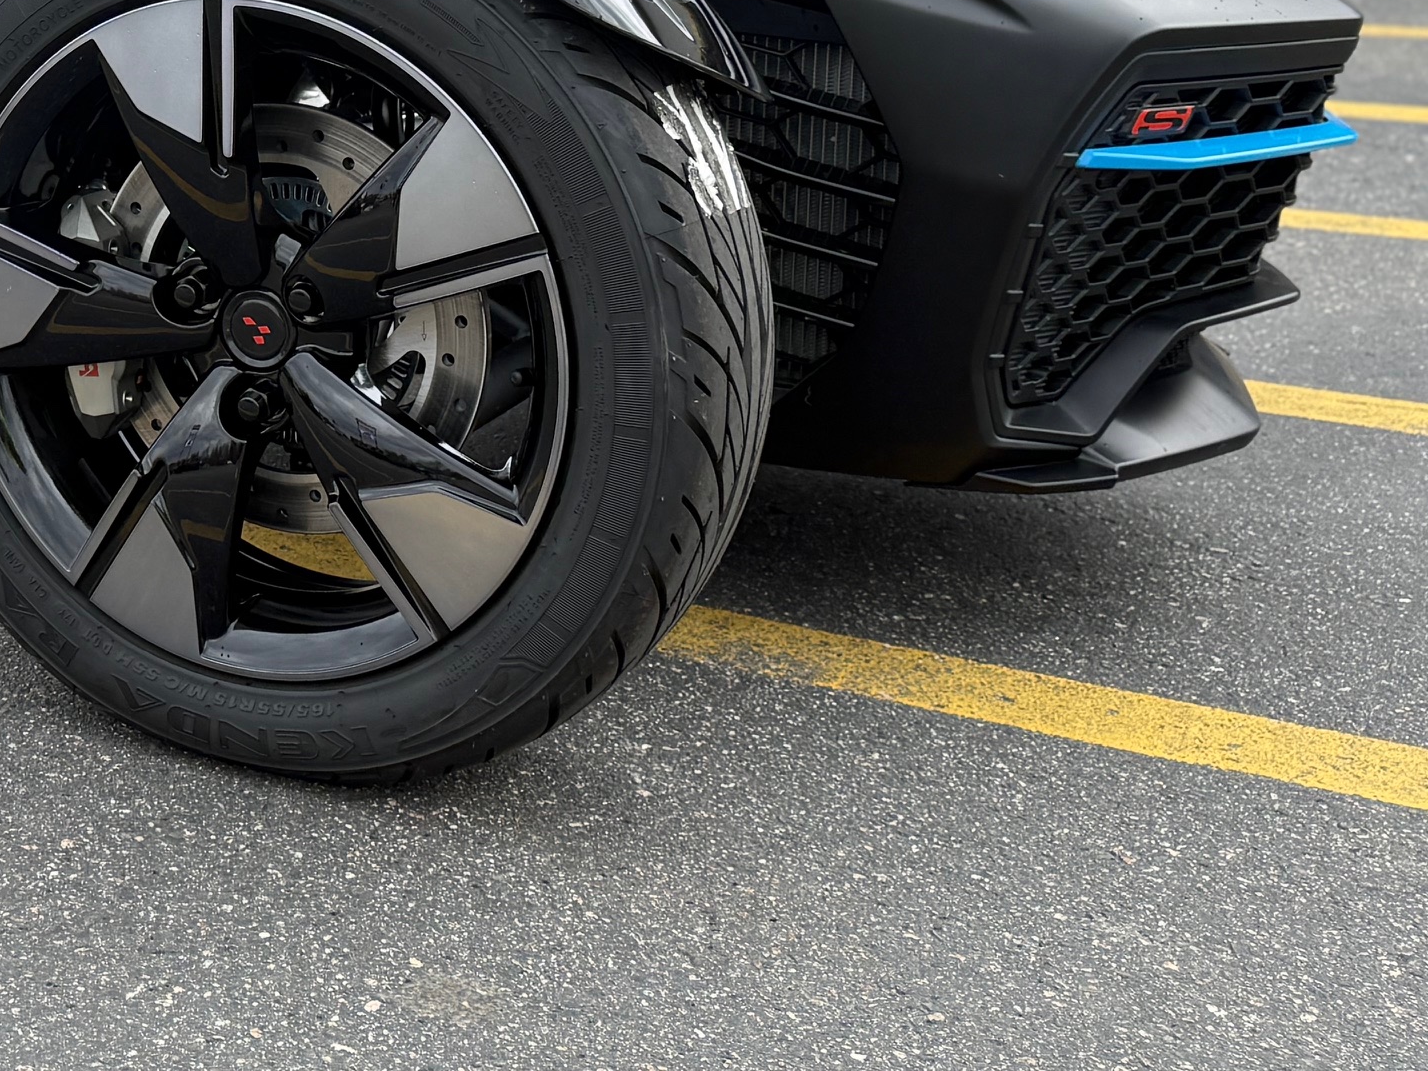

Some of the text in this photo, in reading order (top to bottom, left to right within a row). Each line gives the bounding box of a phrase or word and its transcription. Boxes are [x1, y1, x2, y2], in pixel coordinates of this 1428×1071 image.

[164, 672, 208, 700] M/C
[99, 673, 375, 762] KENDA
[213, 691, 336, 720] 165/55R15
